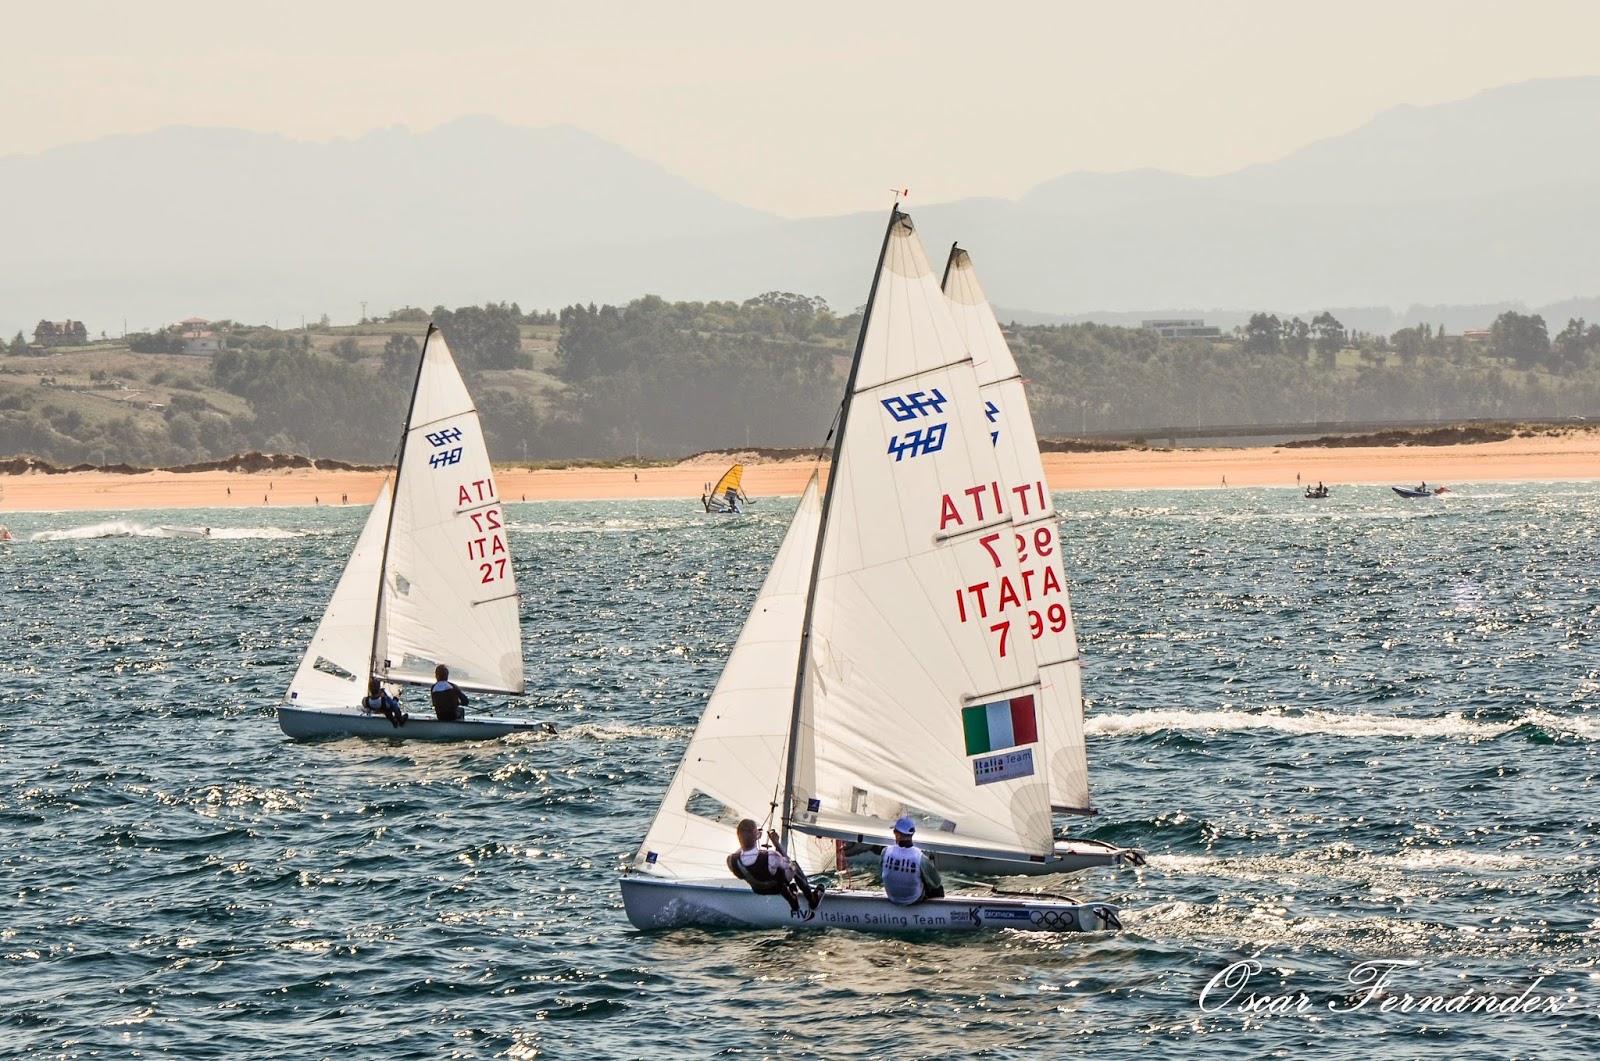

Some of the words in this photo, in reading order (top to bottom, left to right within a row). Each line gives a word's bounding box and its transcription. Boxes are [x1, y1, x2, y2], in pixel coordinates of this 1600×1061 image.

[887, 422, 948, 462] 470
[429, 447, 462, 469] 470
[467, 534, 506, 560] ITA
[480, 558, 507, 584] 27
[1021, 565, 1061, 601] TA
[956, 575, 1022, 623] ITA
[990, 620, 1010, 658] 7
[975, 757, 1003, 770] Italia
[1005, 752, 1031, 764] Team
[886, 856, 917, 869] Italia
[821, 911, 859, 923] Italian
[865, 913, 907, 926] Sailing
[913, 914, 946, 925] Team
